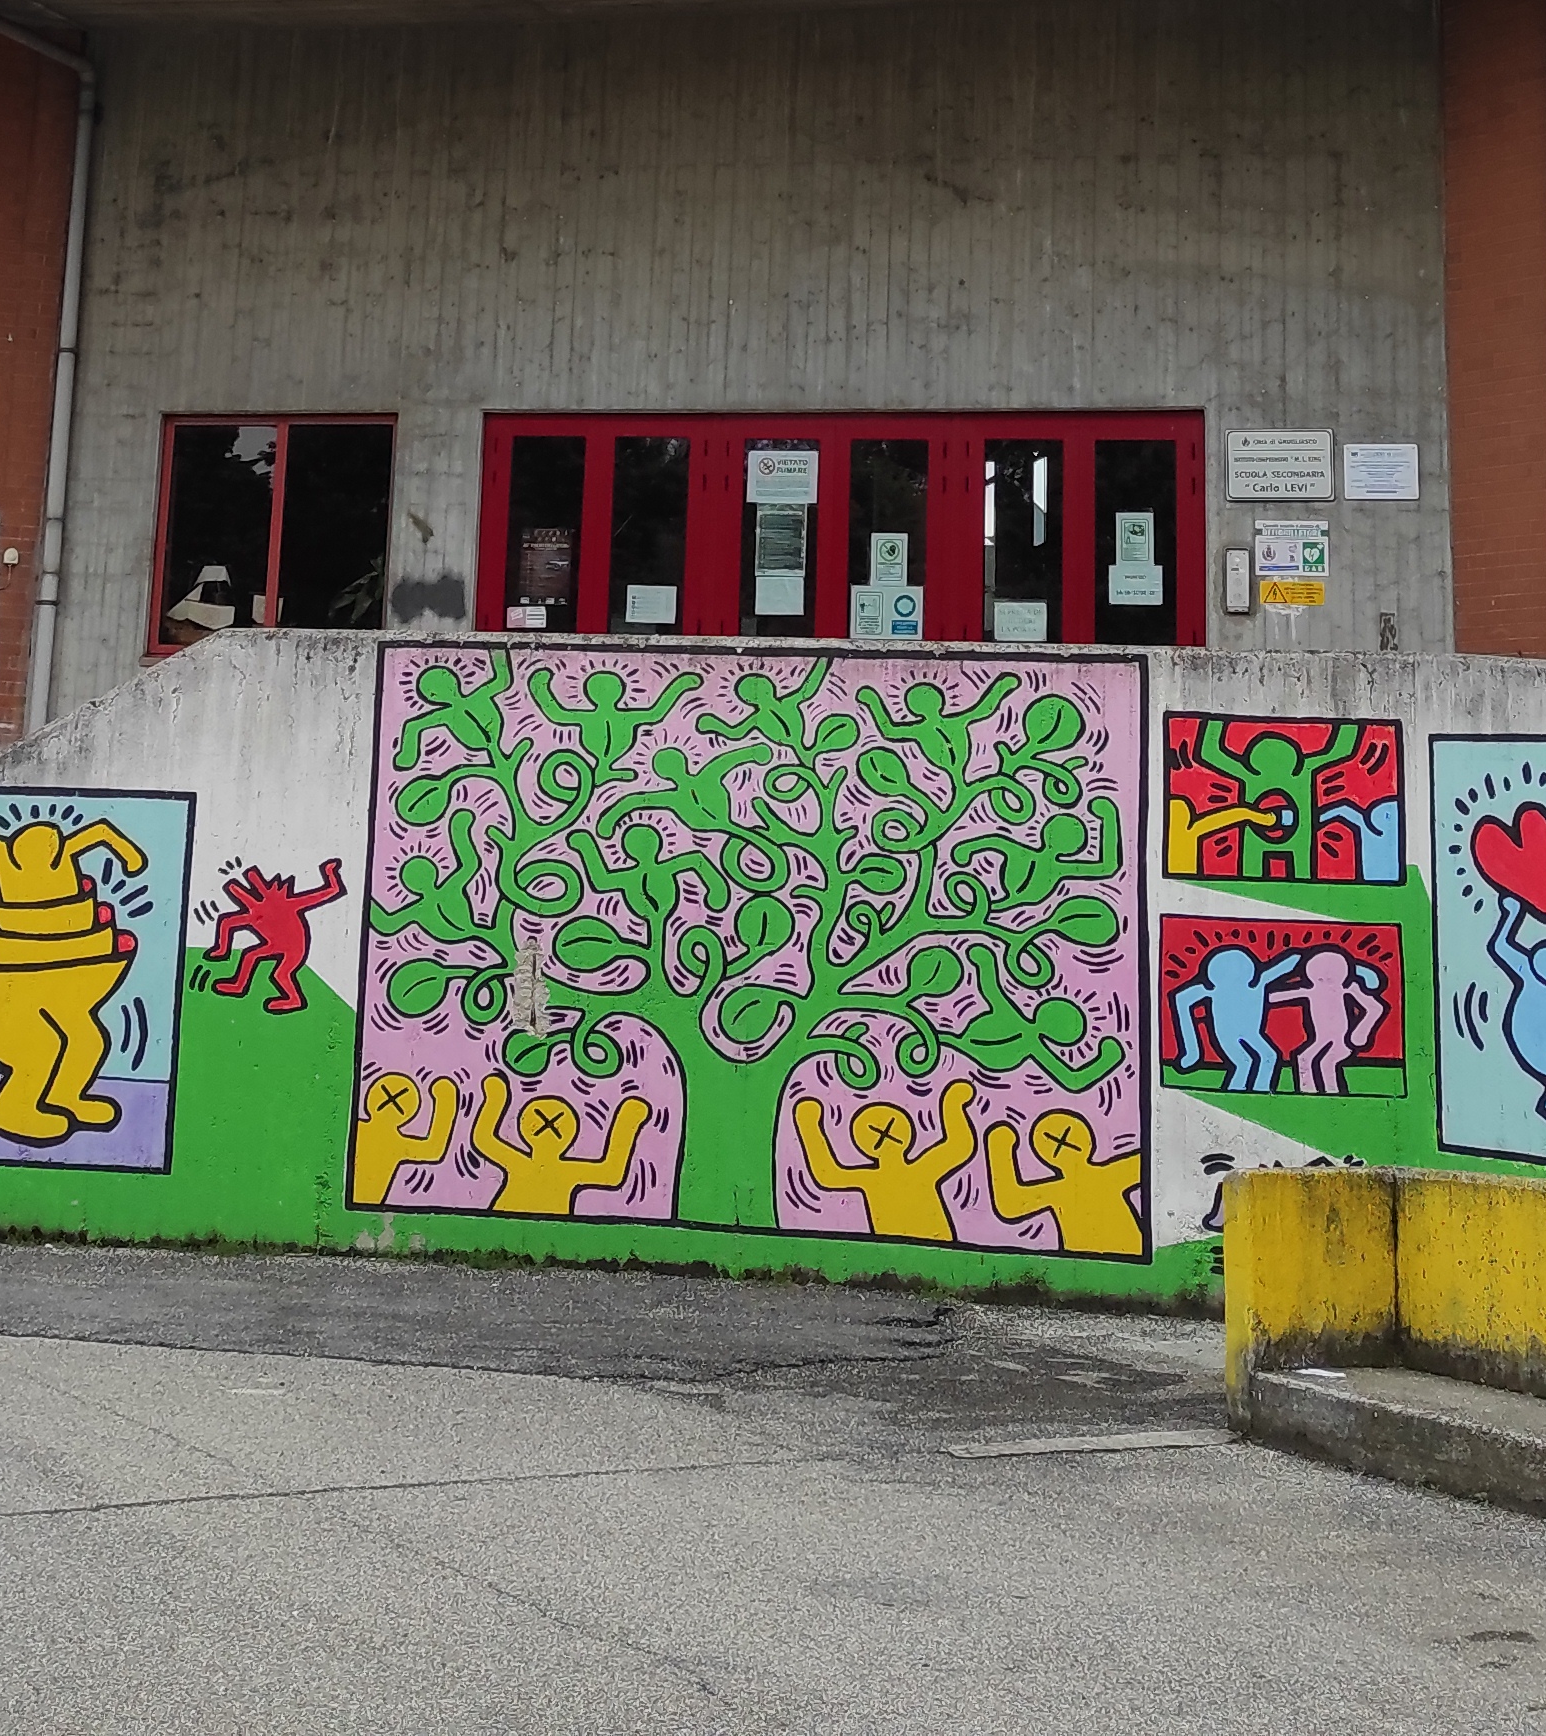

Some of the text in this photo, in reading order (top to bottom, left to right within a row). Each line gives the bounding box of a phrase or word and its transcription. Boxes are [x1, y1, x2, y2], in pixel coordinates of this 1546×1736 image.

[1234, 470, 1326, 479] SCUOLA SECONDARIA
[1252, 482, 1308, 493] Carlo LEVI
